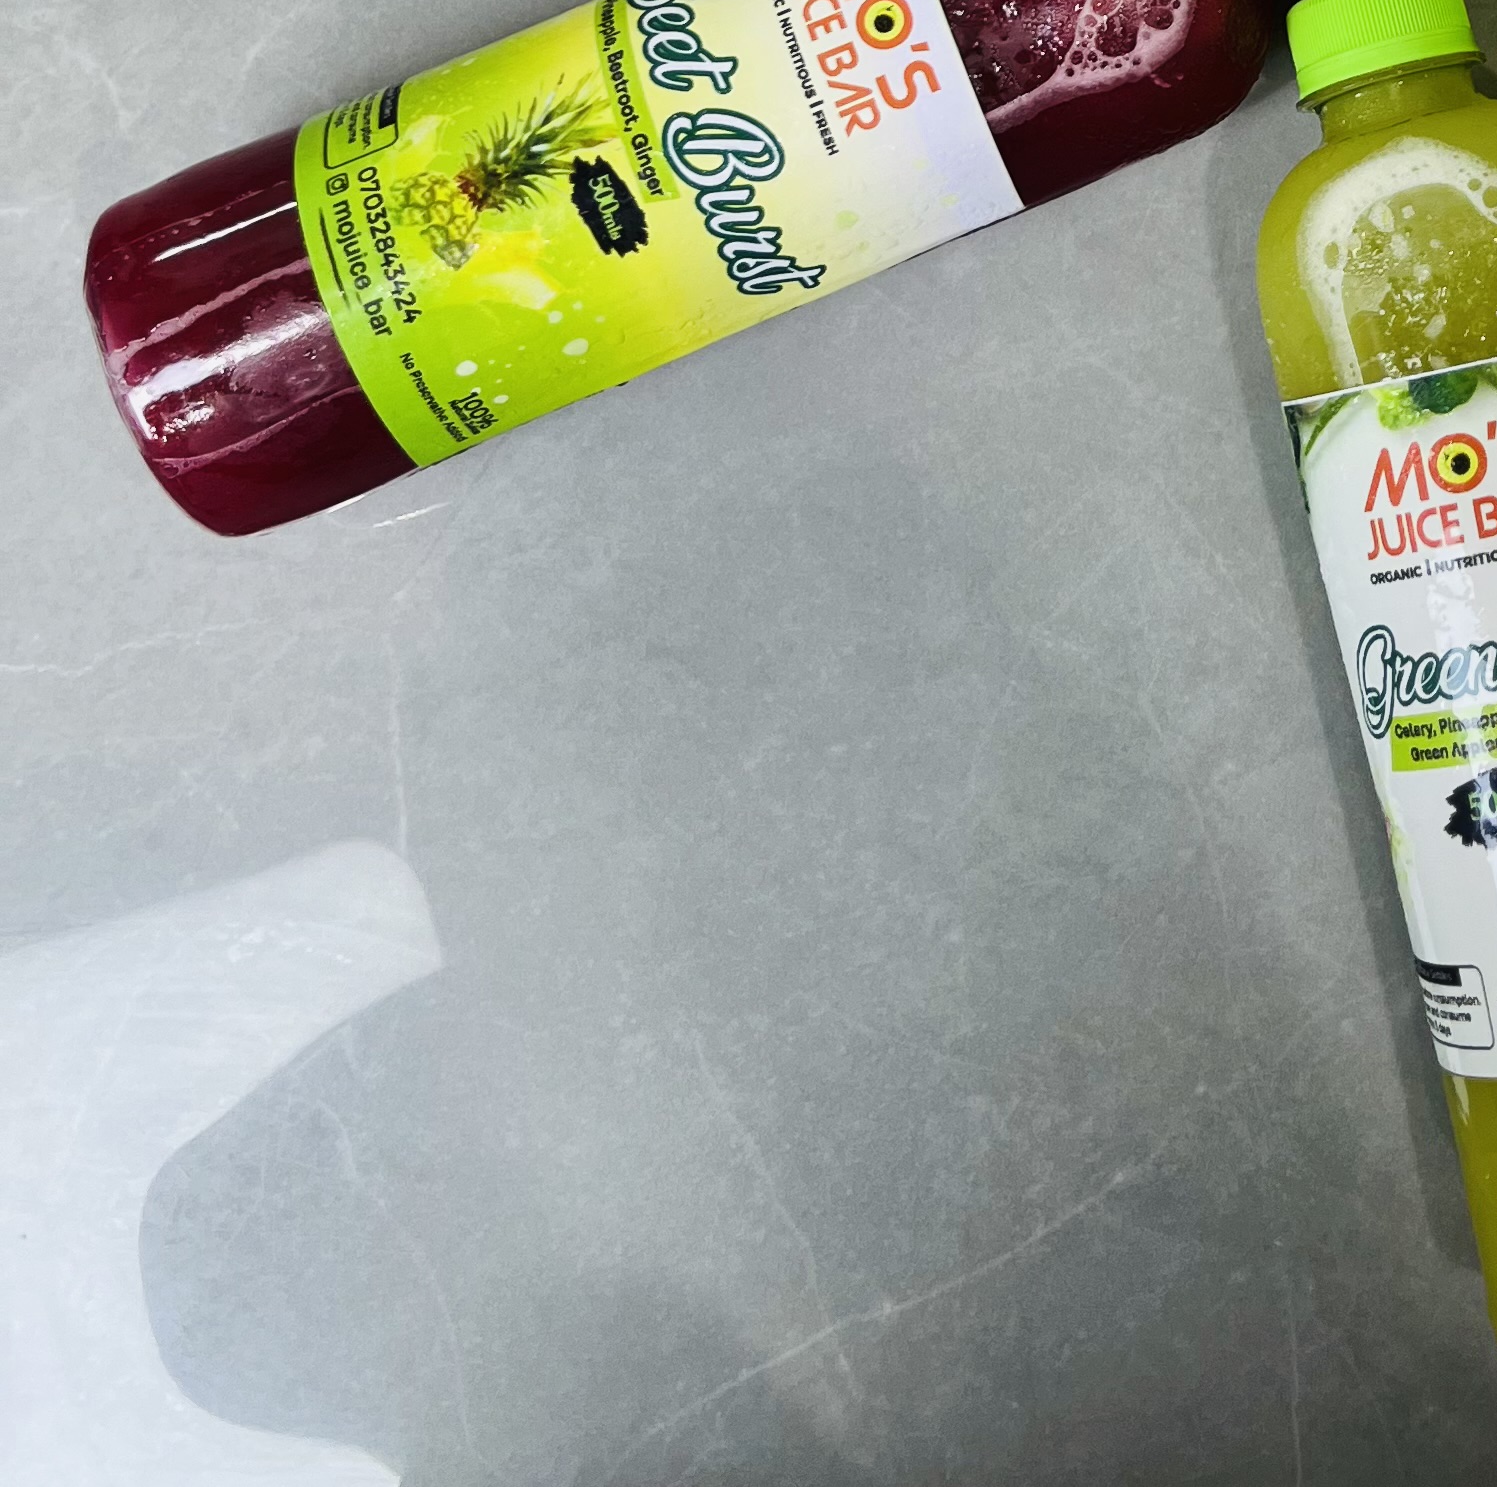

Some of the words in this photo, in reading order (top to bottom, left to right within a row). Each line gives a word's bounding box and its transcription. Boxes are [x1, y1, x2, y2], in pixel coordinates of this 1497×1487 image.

[605, 48, 641, 132] Beetroot,
[630, 130, 664, 198] Ginger
[778, 15, 817, 99] NUTRITIOUS
[811, 108, 839, 156] FRESH
[816, 40, 881, 138] BAR
[356, 165, 423, 324] 07032843424
[660, 110, 826, 298] Burst
[332, 198, 393, 337] mojuice_bar
[398, 351, 416, 371] No
[408, 369, 449, 422] Preservative
[456, 391, 499, 429] 100%
[1367, 502, 1465, 560] JUICE
[1369, 565, 1423, 585] ORGANIC
[1410, 743, 1448, 763] Green
